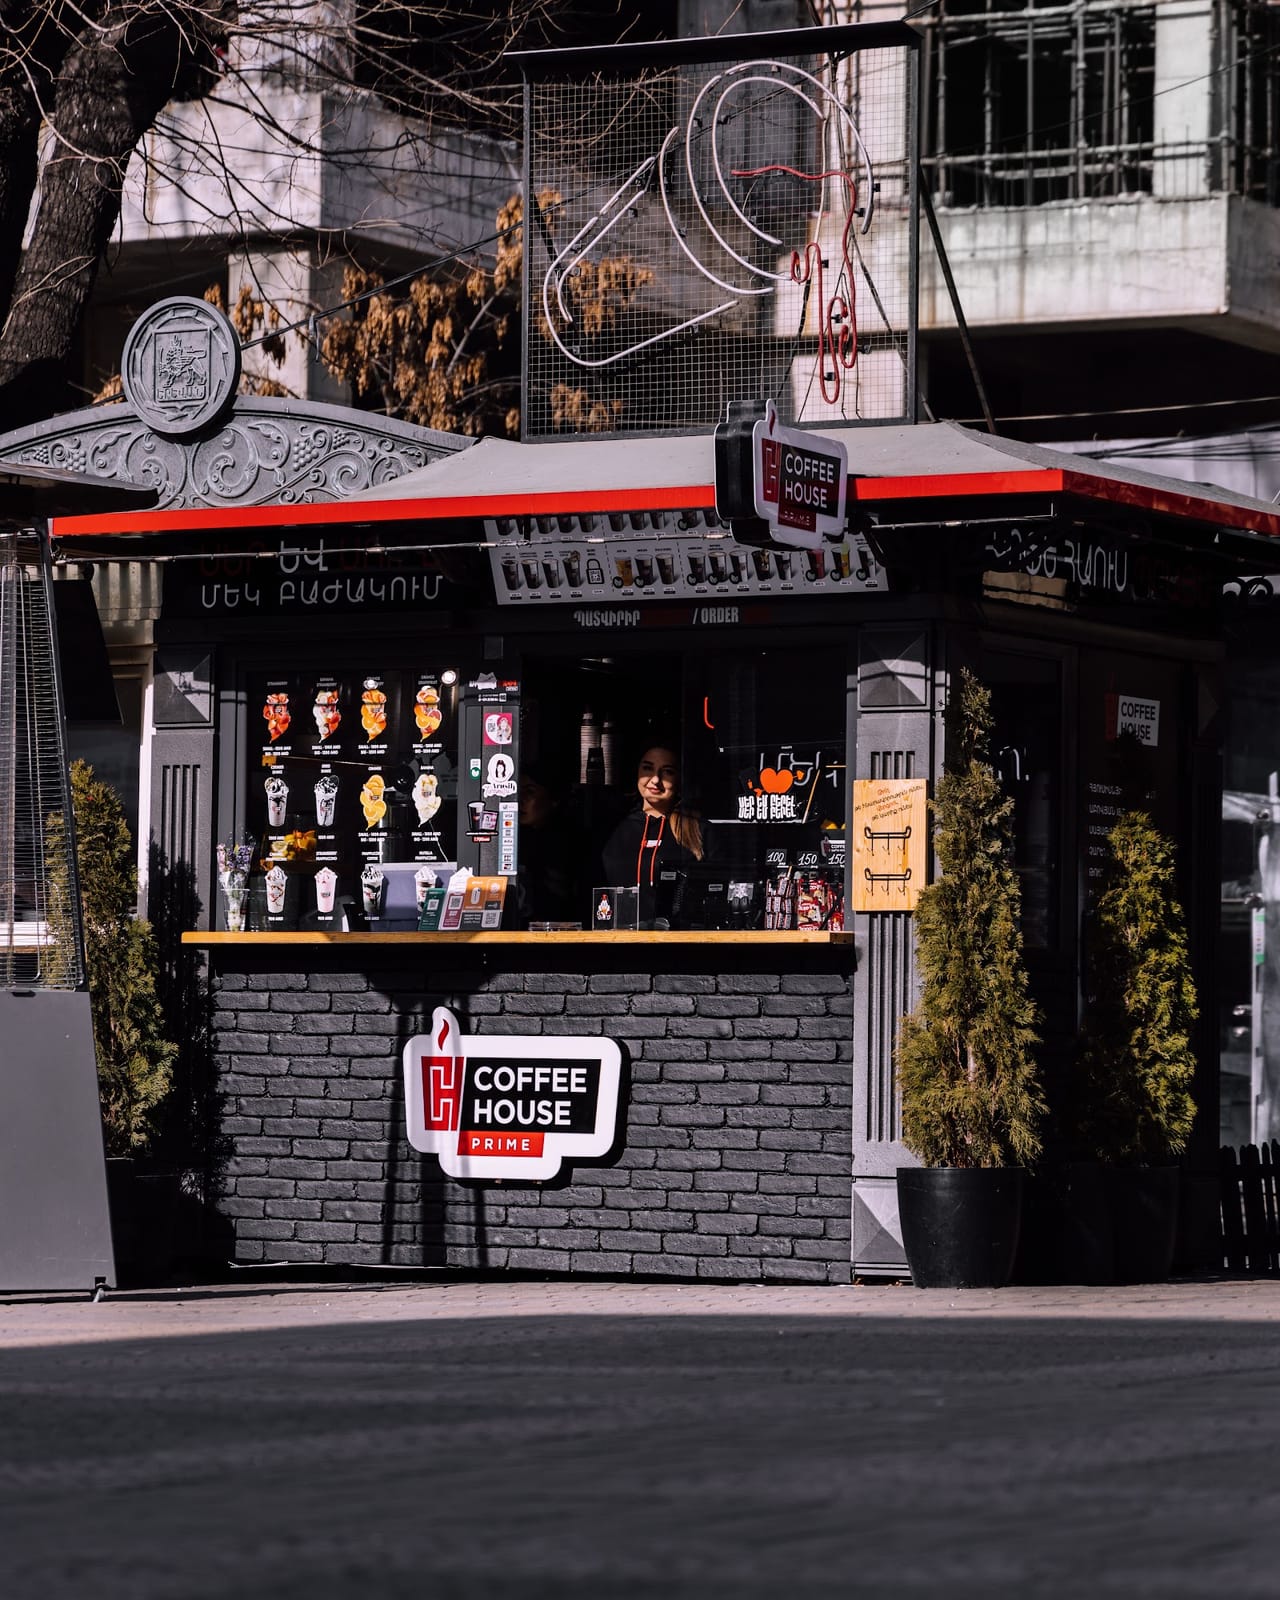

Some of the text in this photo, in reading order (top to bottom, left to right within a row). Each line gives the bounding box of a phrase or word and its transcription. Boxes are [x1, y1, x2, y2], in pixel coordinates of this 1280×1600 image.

[785, 453, 834, 484] COFFEE
[784, 479, 828, 509] HOUSE
[279, 538, 328, 573] ԵՎ
[201, 575, 444, 609] ՄԵԿ ԲԱԺԱԿՈՒՄ
[700, 606, 740, 625] ORDER
[1120, 701, 1156, 721] COFFEE
[1120, 722, 1152, 741] HOUSE
[767, 851, 785, 863] 100
[798, 852, 818, 866] 150
[473, 1065, 588, 1094] COFFEE
[473, 1099, 572, 1126] HOUSE
[471, 1137, 531, 1152] PRIME
